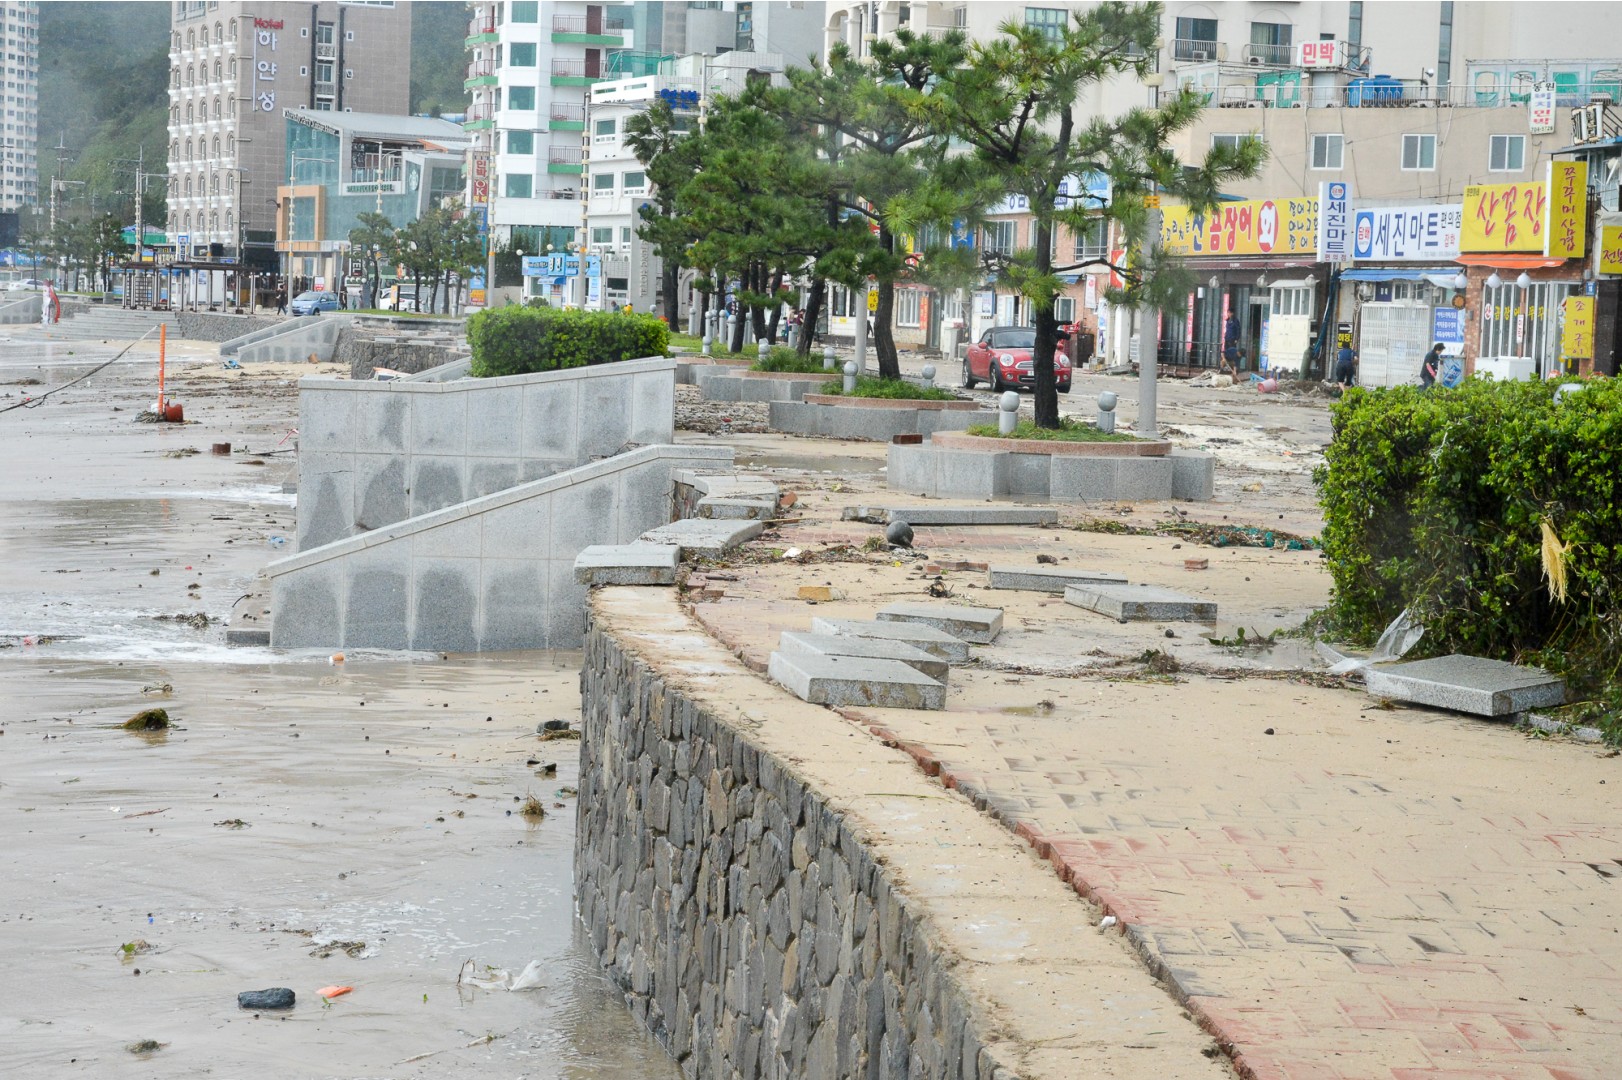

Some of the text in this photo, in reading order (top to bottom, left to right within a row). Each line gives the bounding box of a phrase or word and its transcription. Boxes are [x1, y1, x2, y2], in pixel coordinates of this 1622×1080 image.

[254, 17, 284, 30] Hotel
[257, 30, 278, 112] 하얀성
[1302, 42, 1335, 65] 민박
[475, 180, 486, 196] OK
[1258, 203, 1276, 249] 회
[1326, 201, 1347, 253] 세진마트
[1375, 211, 1439, 257] 세진마트
[1440, 210, 1462, 229] 편의점
[1573, 300, 1586, 355] 조개구이
